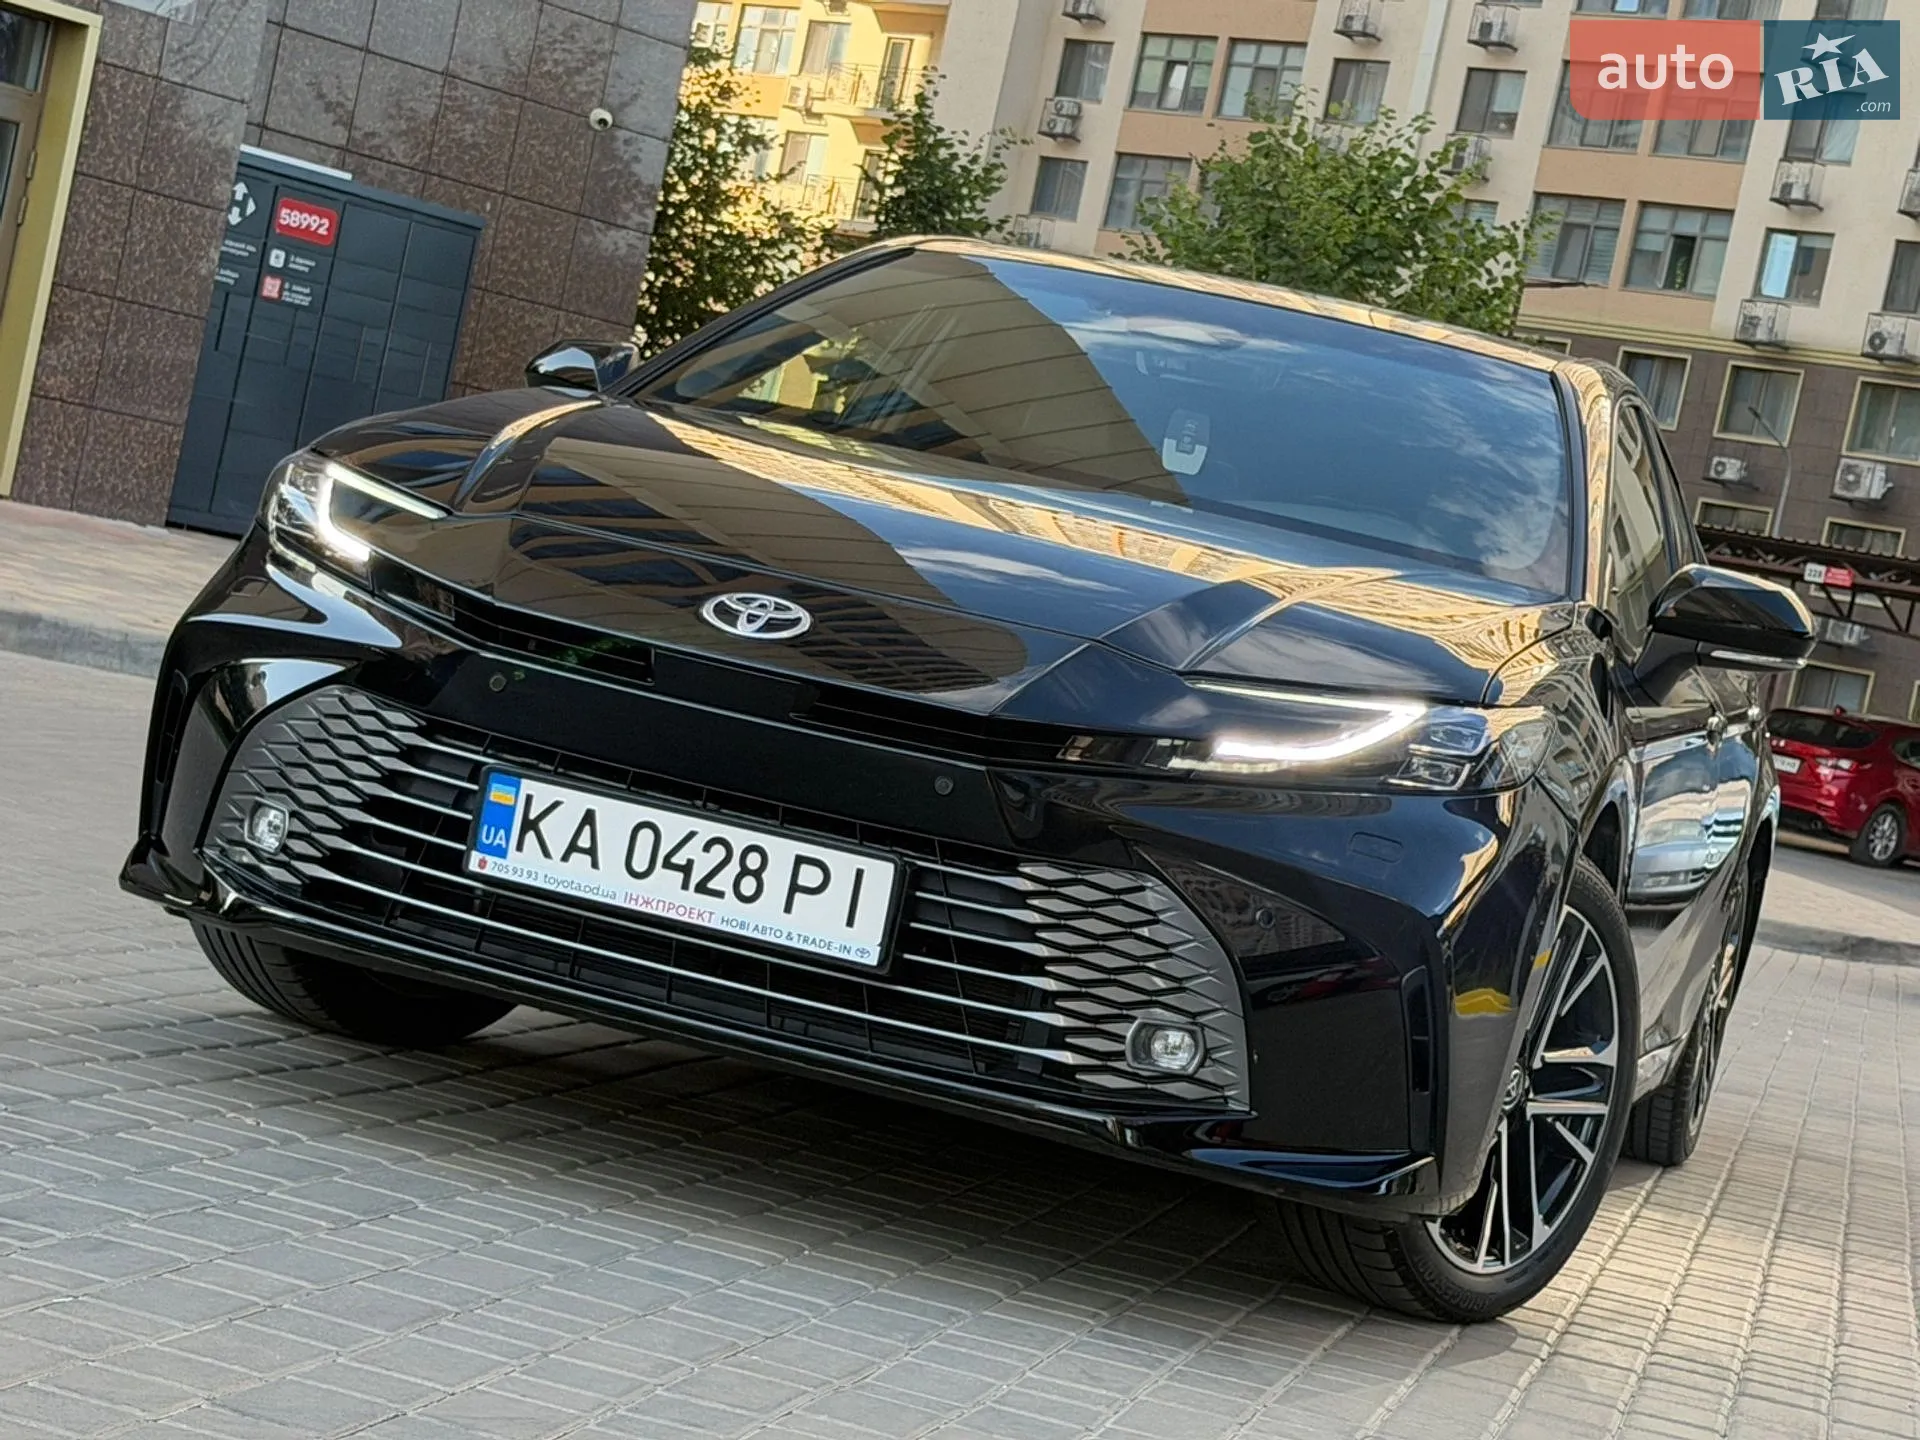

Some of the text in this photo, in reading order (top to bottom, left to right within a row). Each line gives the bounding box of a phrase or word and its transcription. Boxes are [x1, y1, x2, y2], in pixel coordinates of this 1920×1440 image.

[279, 207, 330, 236] 58992
[481, 824, 508, 850] UA
[515, 793, 601, 871] KA
[623, 820, 769, 904] 0428
[491, 860, 509, 874] 705
[510, 866, 523, 878] 93
[526, 869, 539, 881] 93
[623, 891, 716, 924] ІНЖПРОЕКТ
[719, 915, 750, 932] НОВІ
[752, 924, 783, 939] АВТО
[785, 931, 793, 941] &
[795, 933, 853, 956] TRADE-IN
